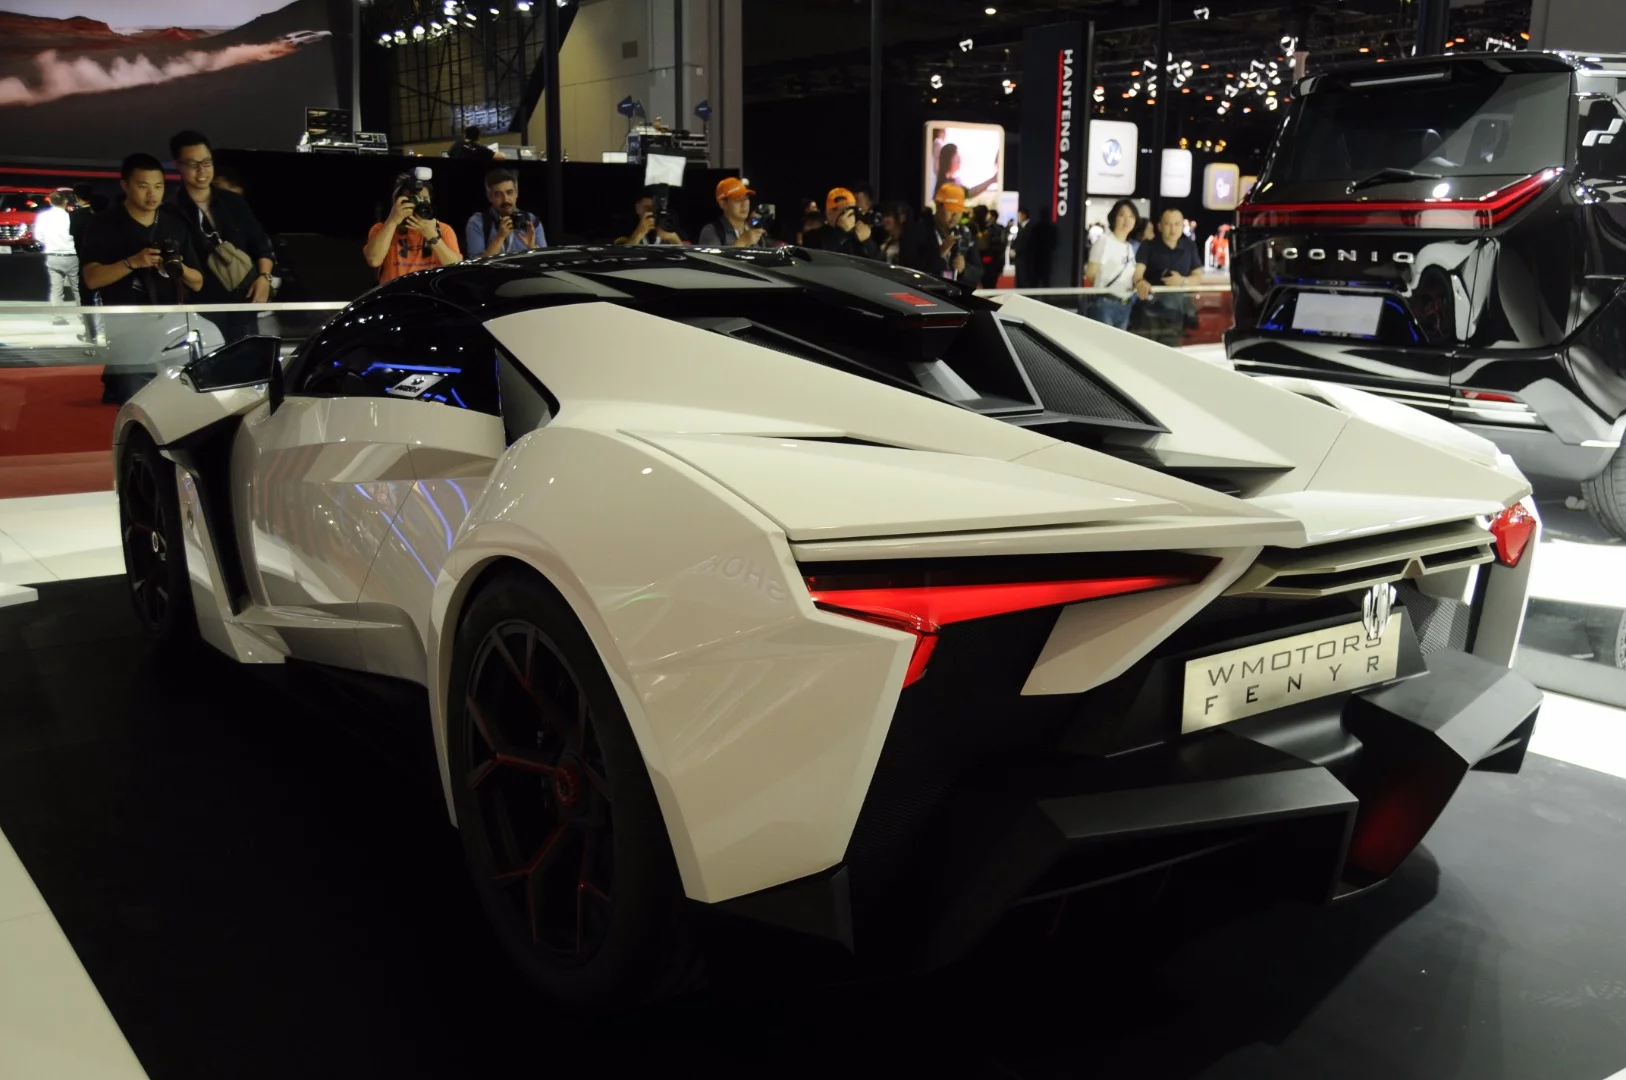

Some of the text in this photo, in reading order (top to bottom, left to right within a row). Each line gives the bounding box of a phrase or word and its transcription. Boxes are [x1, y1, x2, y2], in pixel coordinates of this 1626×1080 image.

[1056, 49, 1074, 217] HANTENG AUTO
[1204, 655, 1380, 716] FENYR
